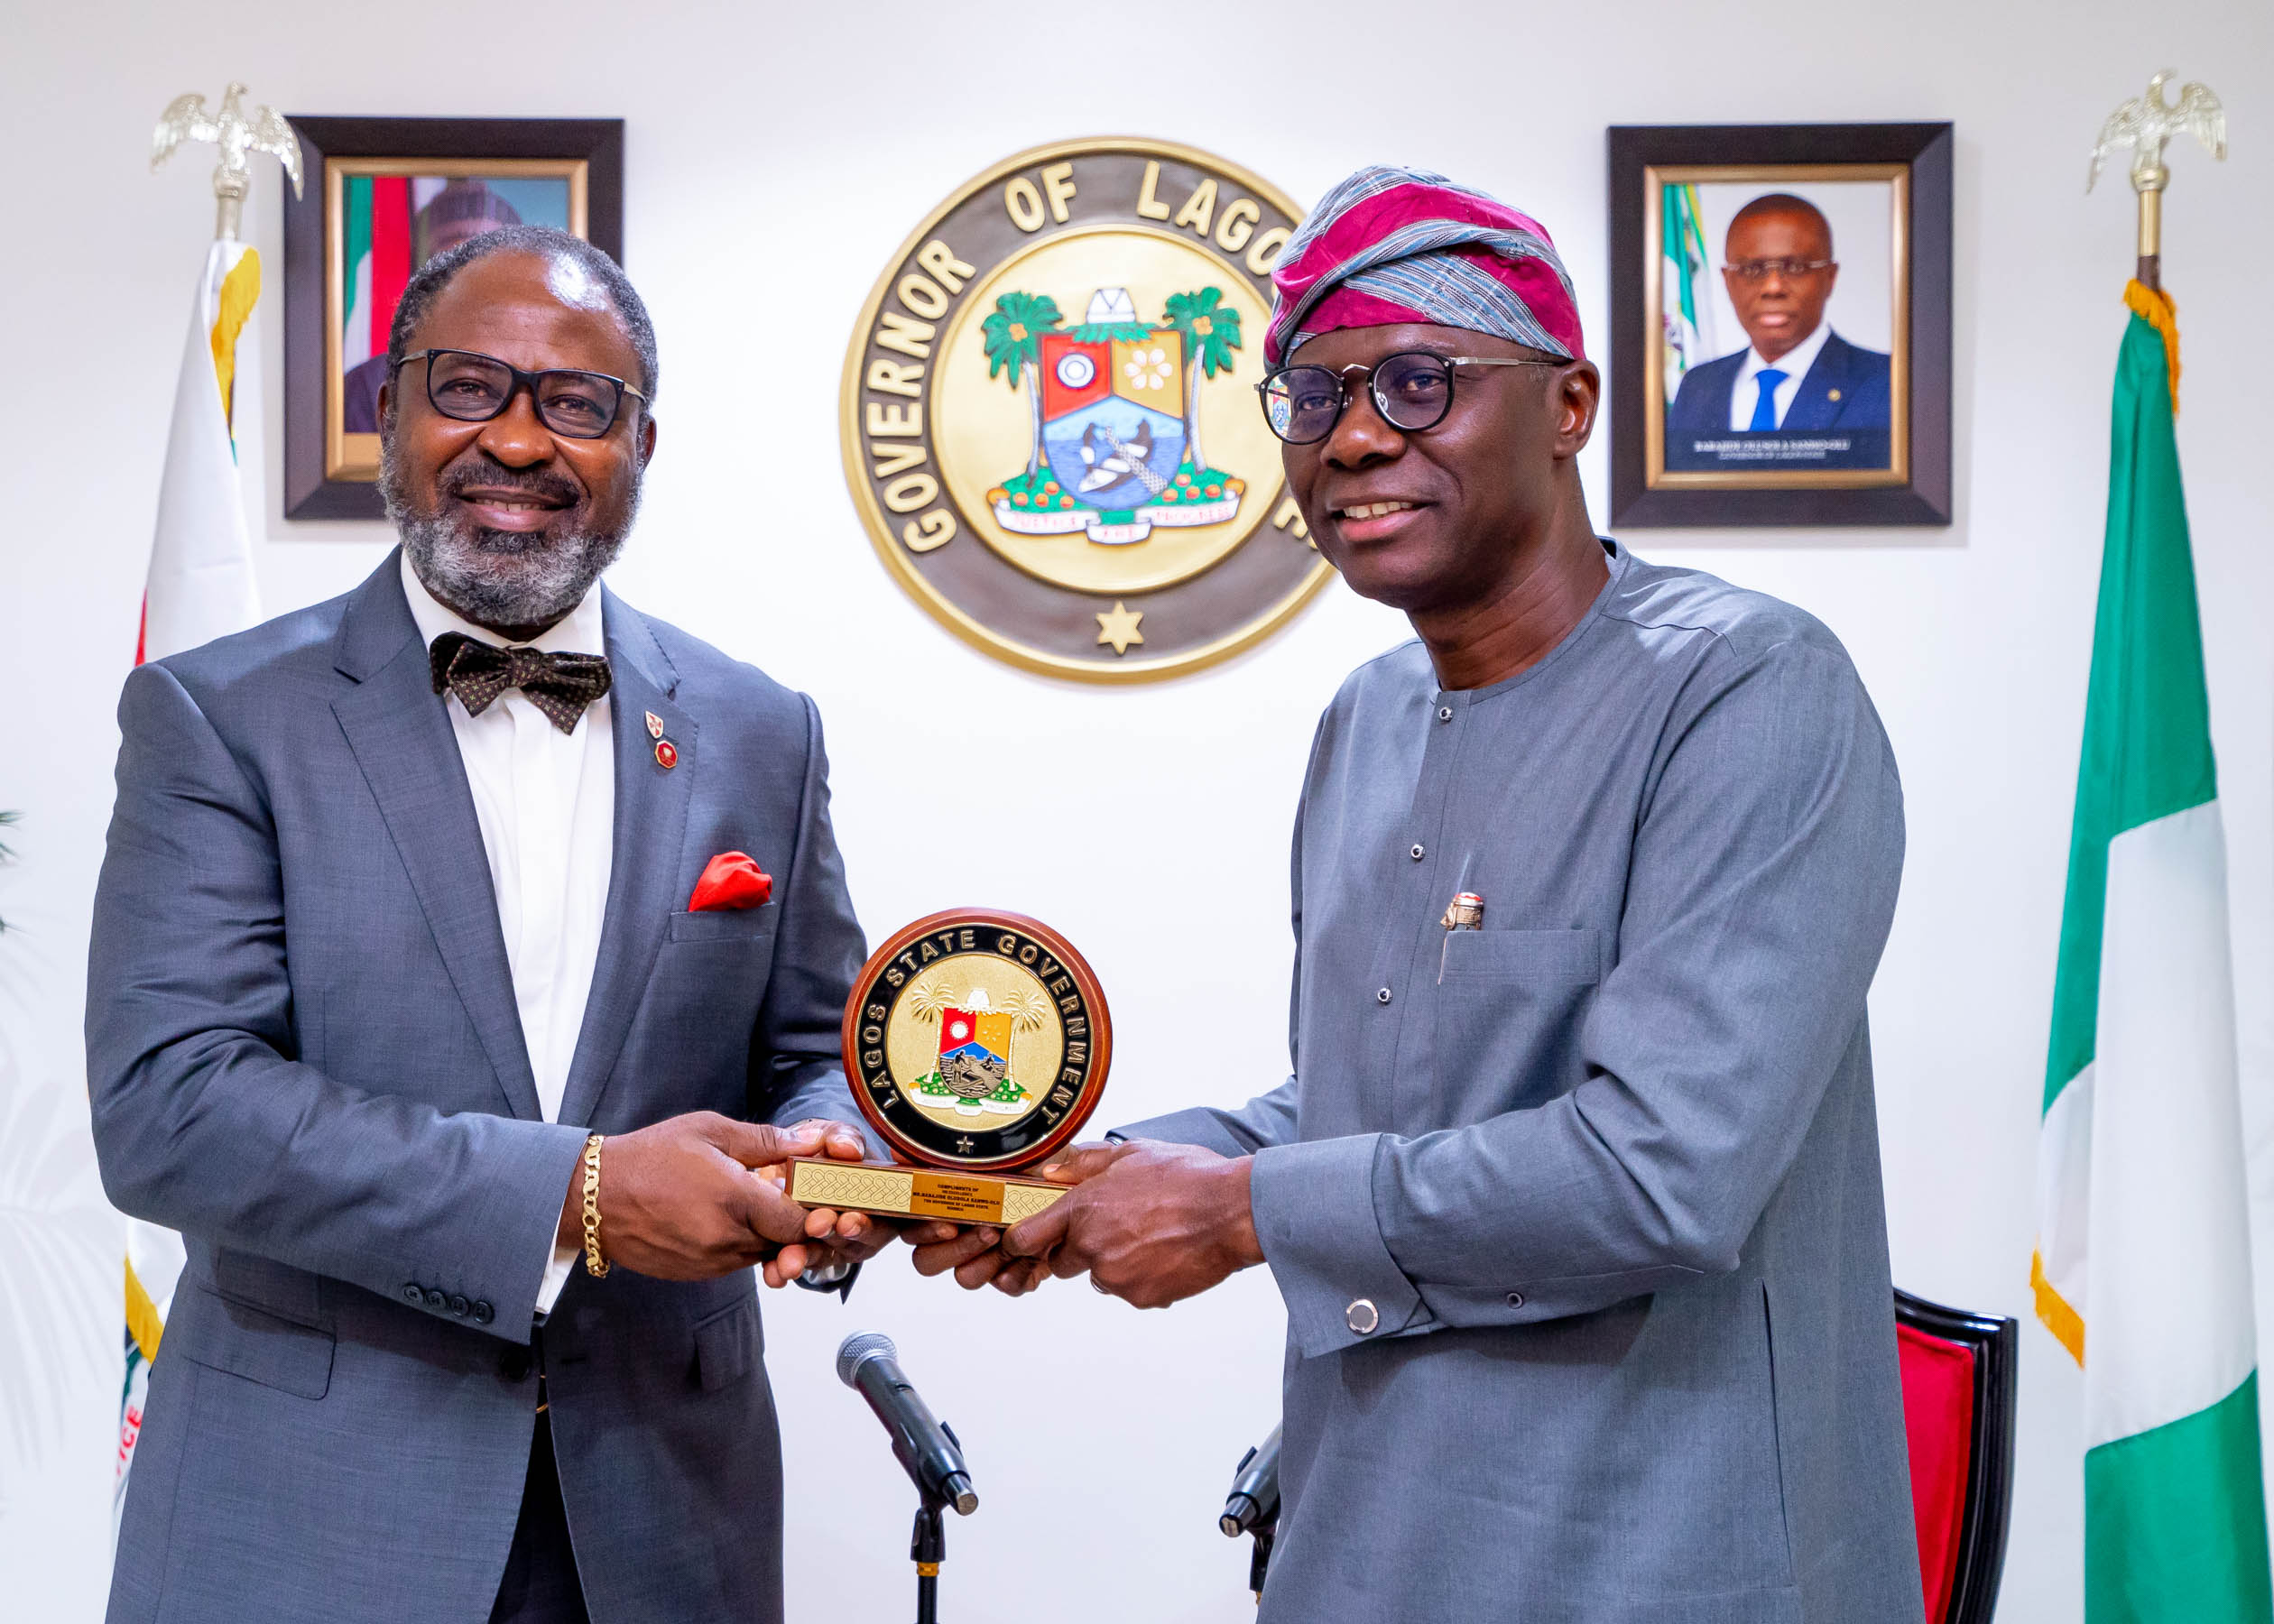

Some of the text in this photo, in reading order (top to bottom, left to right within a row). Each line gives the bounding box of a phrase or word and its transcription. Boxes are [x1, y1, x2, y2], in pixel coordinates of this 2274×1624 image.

[865, 160, 1293, 553] GOVERNOR OF LAGO
[864, 929, 1088, 1125] LAGOS STATE GOVERNMENT
